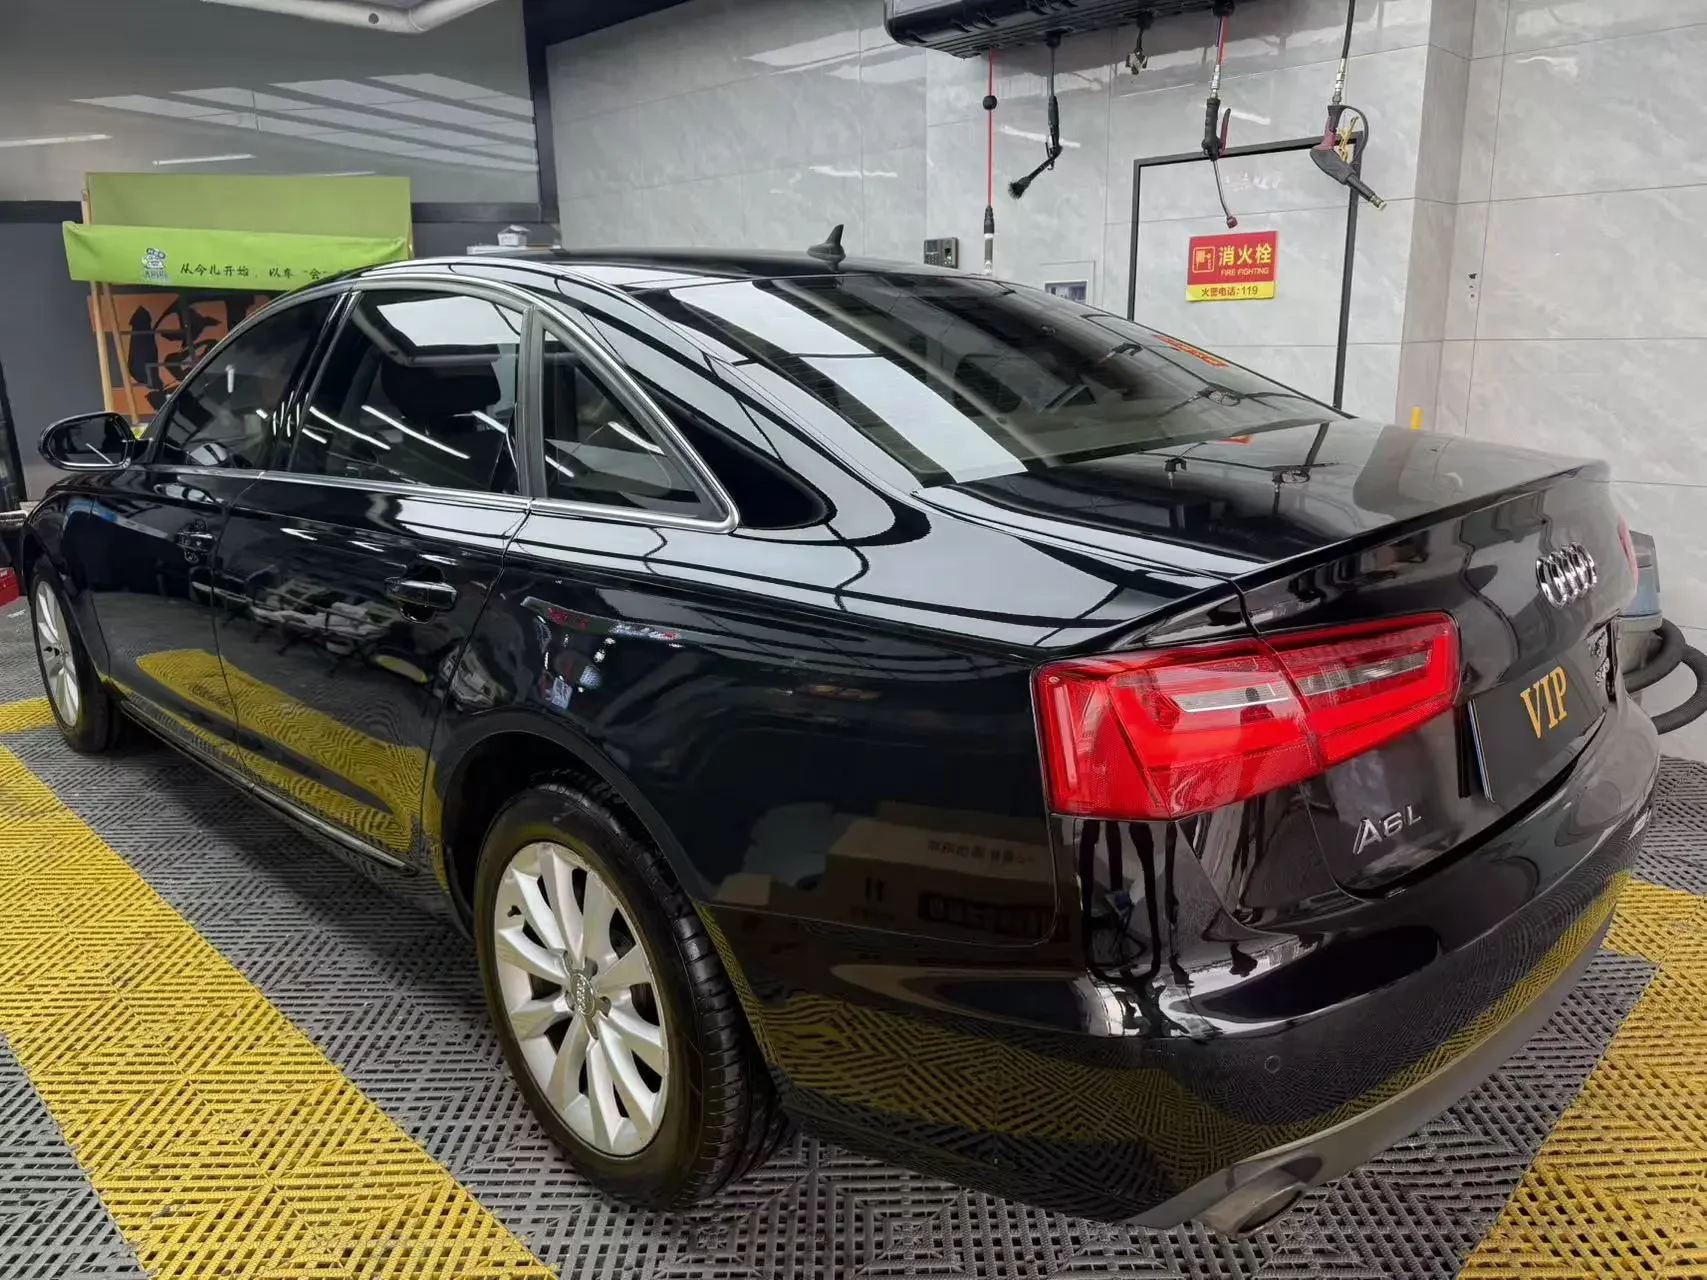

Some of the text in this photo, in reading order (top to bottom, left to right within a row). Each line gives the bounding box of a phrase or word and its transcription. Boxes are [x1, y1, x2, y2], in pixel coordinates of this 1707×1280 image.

[1218, 242, 1272, 266] 消火栓
[1221, 267, 1269, 276] FIRE FIGHTING
[1520, 666, 1568, 738] VIP
[1352, 804, 1422, 855] A6L
